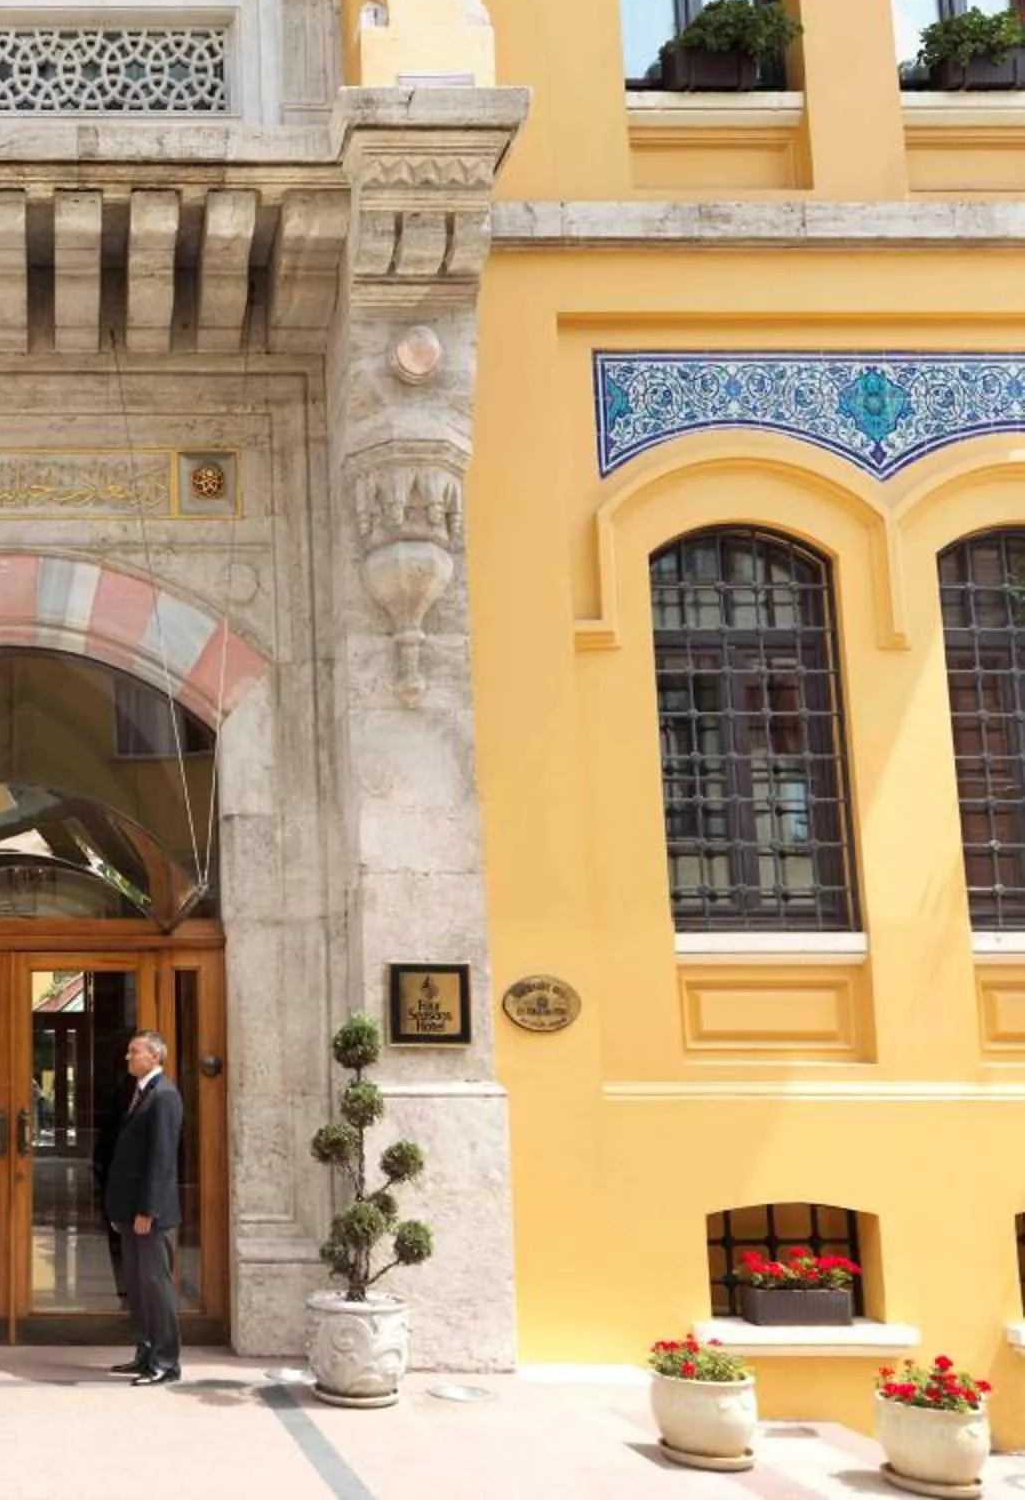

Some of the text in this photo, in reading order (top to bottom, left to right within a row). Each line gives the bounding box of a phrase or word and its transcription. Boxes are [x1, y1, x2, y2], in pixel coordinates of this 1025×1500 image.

[418, 999, 440, 1011] Four
[408, 1007, 453, 1021] Seasons
[416, 1019, 446, 1032] Hotel
